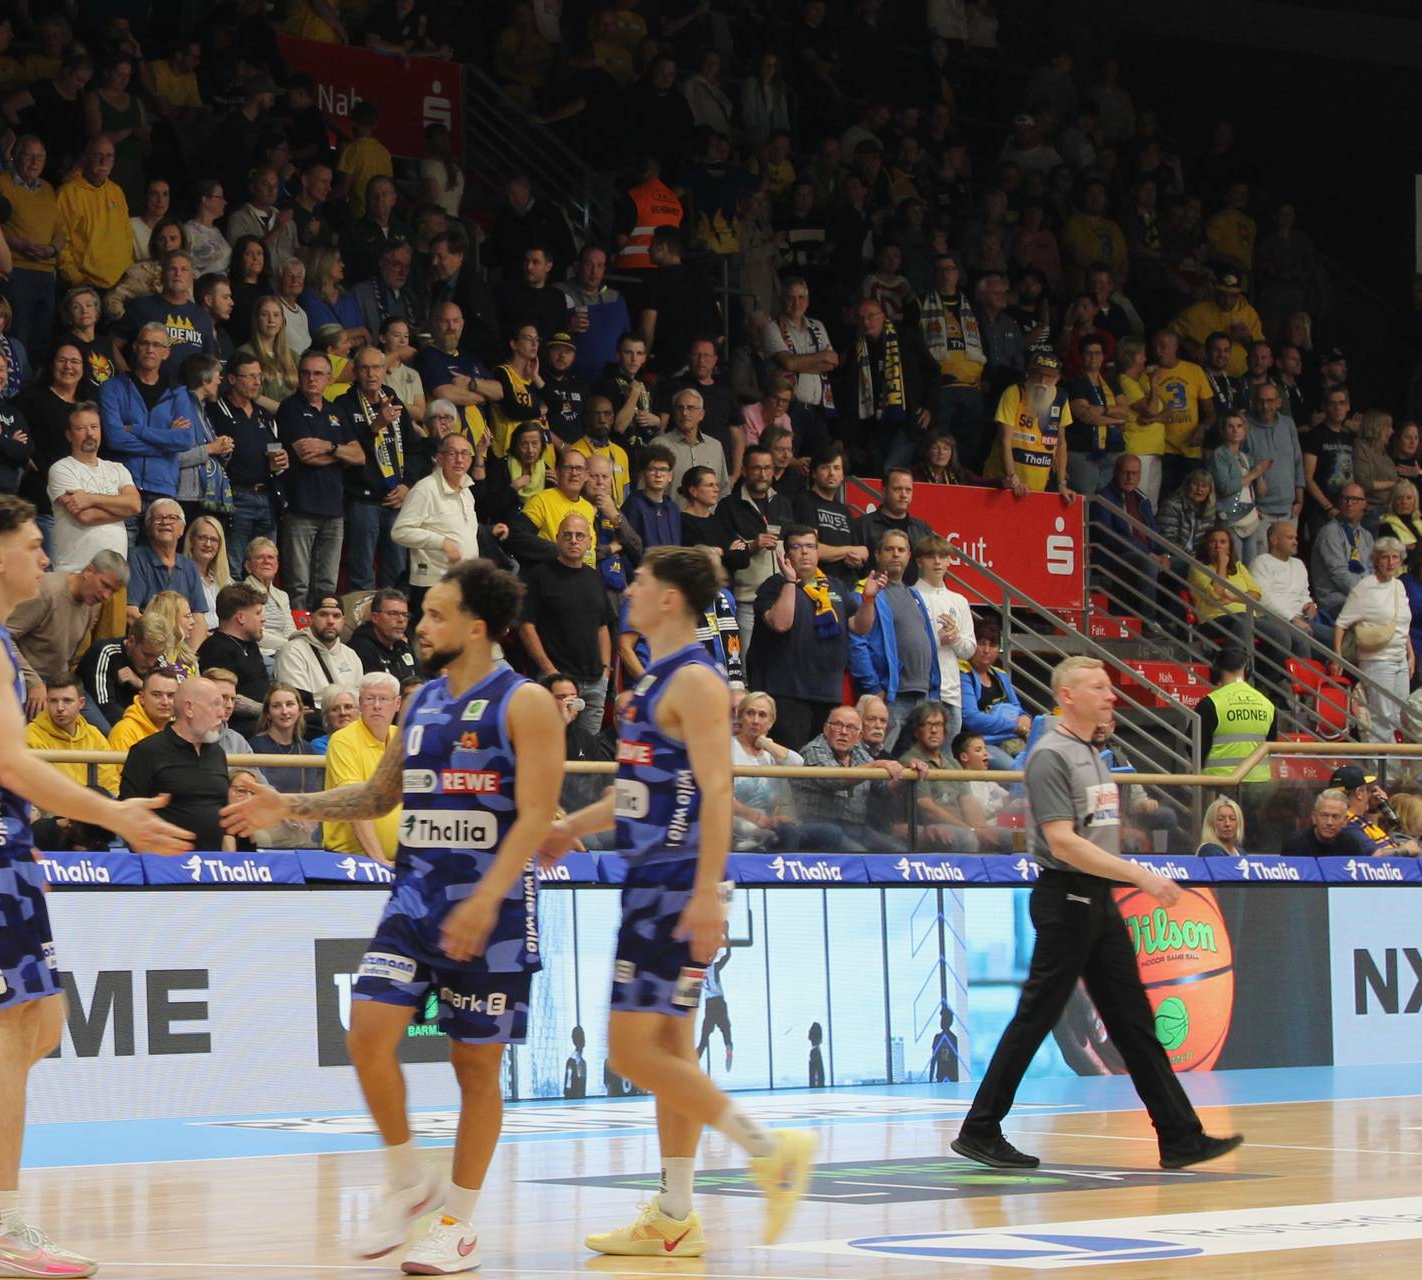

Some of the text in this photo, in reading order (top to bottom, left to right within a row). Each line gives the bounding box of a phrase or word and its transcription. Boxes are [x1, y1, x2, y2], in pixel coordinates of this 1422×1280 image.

[166, 327, 203, 345] OENIX
[1165, 383, 1187, 409] 3
[1024, 452, 1052, 466] Thalia
[1091, 625, 1106, 636] Fair.
[1226, 709, 1268, 722] ORDNER
[441, 772, 496, 792] REWE
[418, 818, 487, 843] Thalia
[666, 807, 691, 841] wilo
[41, 857, 110, 884] Thalia
[208, 859, 273, 883] Thalia
[788, 860, 842, 882] Thalia
[910, 861, 965, 882] Thalia
[1250, 862, 1300, 881] Thalia
[1357, 862, 1403, 881] Thalia
[407, 1025, 446, 1037] BARM
